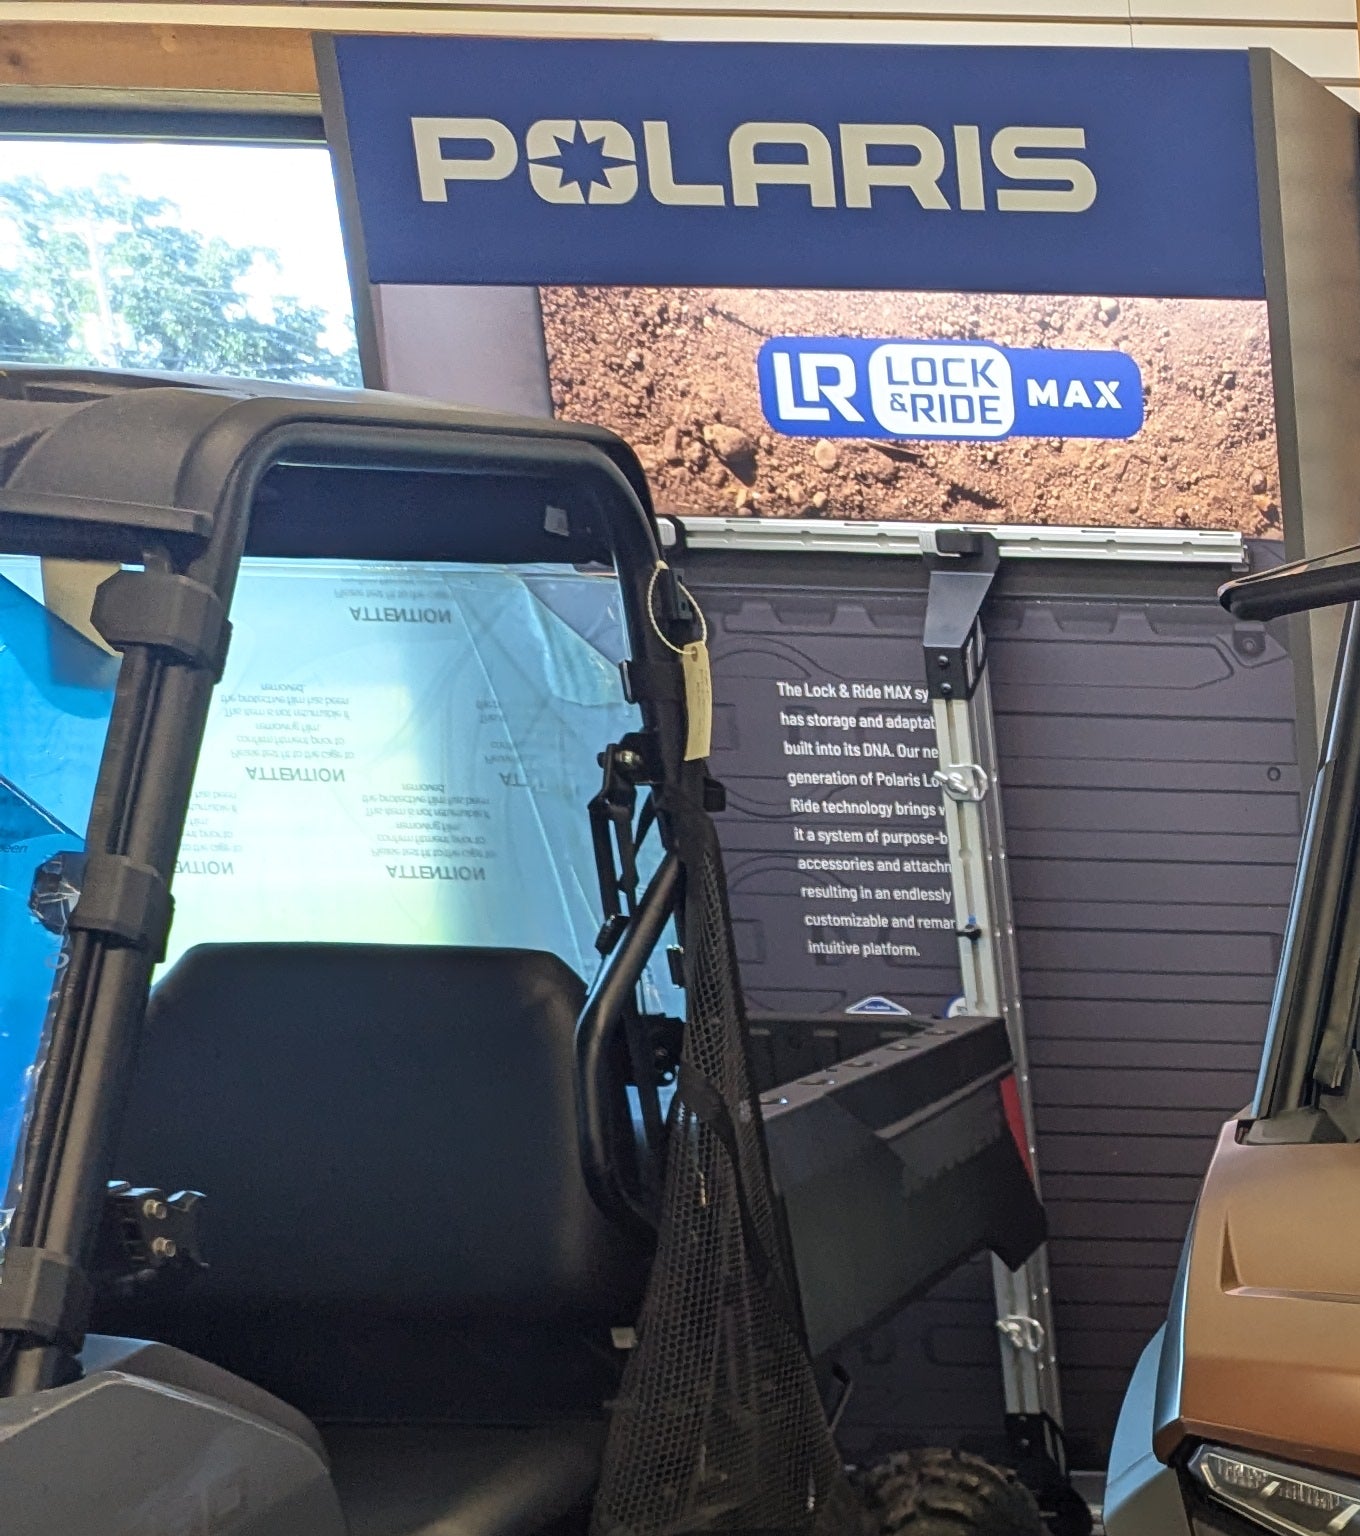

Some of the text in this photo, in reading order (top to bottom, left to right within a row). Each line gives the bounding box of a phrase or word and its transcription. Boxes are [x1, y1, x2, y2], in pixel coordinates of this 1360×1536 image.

[411, 116, 1097, 213] POLARIS
[885, 356, 999, 388] LOCK
[772, 352, 866, 422] LR
[1026, 378, 1123, 409] MAX
[776, 681, 929, 703] The Lock & Ride MAX sy
[780, 711, 937, 732] has storage and adaptat
[783, 741, 939, 759] built into its DNA. Our ne
[787, 771, 943, 788] generation of Polaris Lo
[790, 797, 820, 813] Ride
[822, 800, 893, 818] technology
[895, 801, 936, 819] brings
[793, 827, 948, 847] it a system of purpose-b
[0, 844, 28, 853] een
[798, 857, 875, 872] accessories
[877, 858, 900, 872] and
[800, 885, 952, 904] resulting in an endlessly
[804, 912, 956, 929] customizable and remar
[807, 939, 920, 958] intuitive platform.
